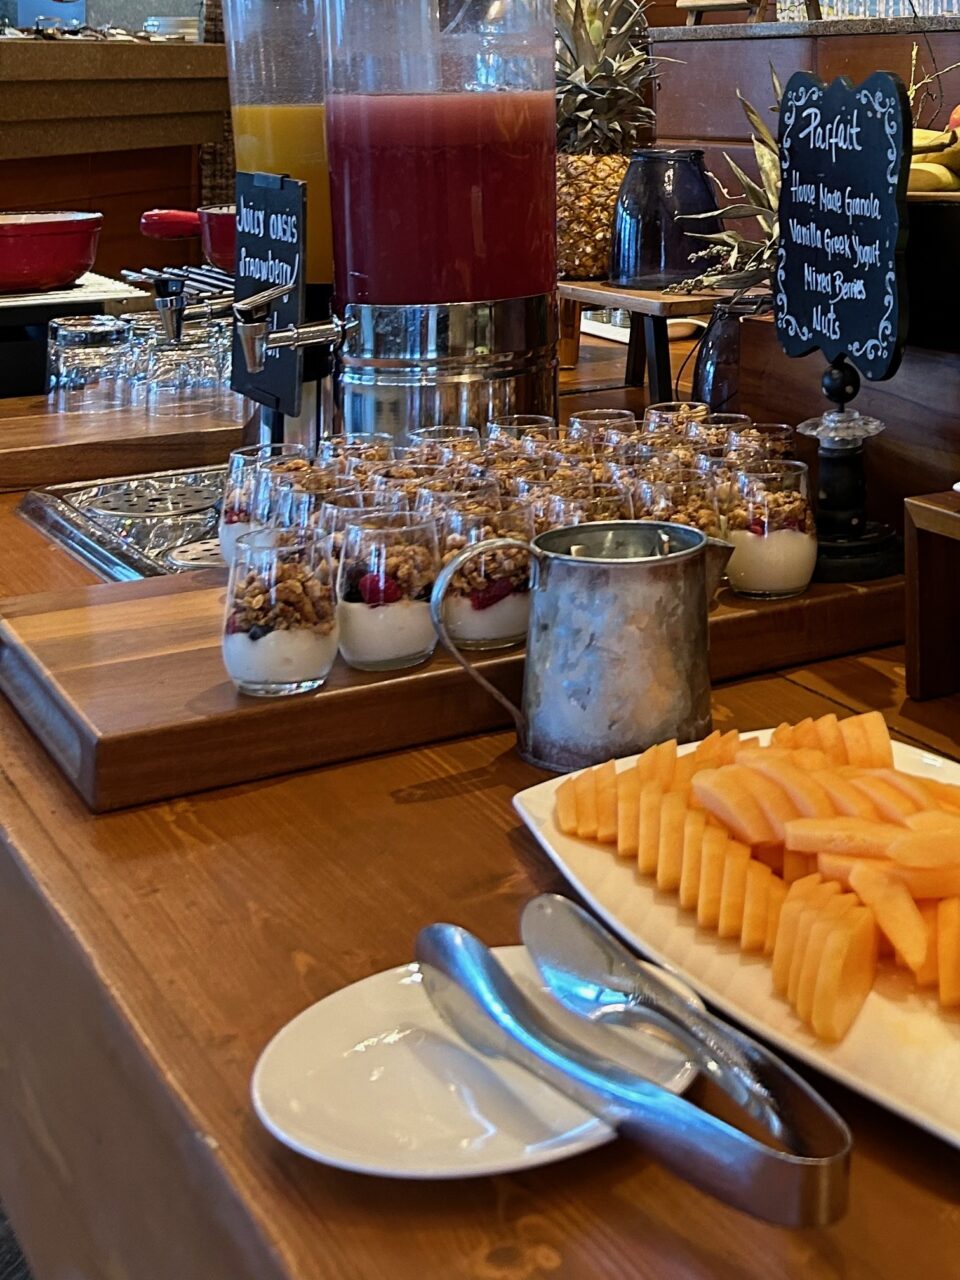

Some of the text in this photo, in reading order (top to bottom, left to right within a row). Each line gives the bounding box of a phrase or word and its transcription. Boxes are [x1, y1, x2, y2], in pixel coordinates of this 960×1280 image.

[799, 107, 863, 163] Parfait
[790, 170, 882, 225] House Made Granola
[788, 218, 881, 272] Vanilla Greek Yogurt
[804, 262, 867, 304] Mixed Berries
[812, 305, 841, 340] Nuts
